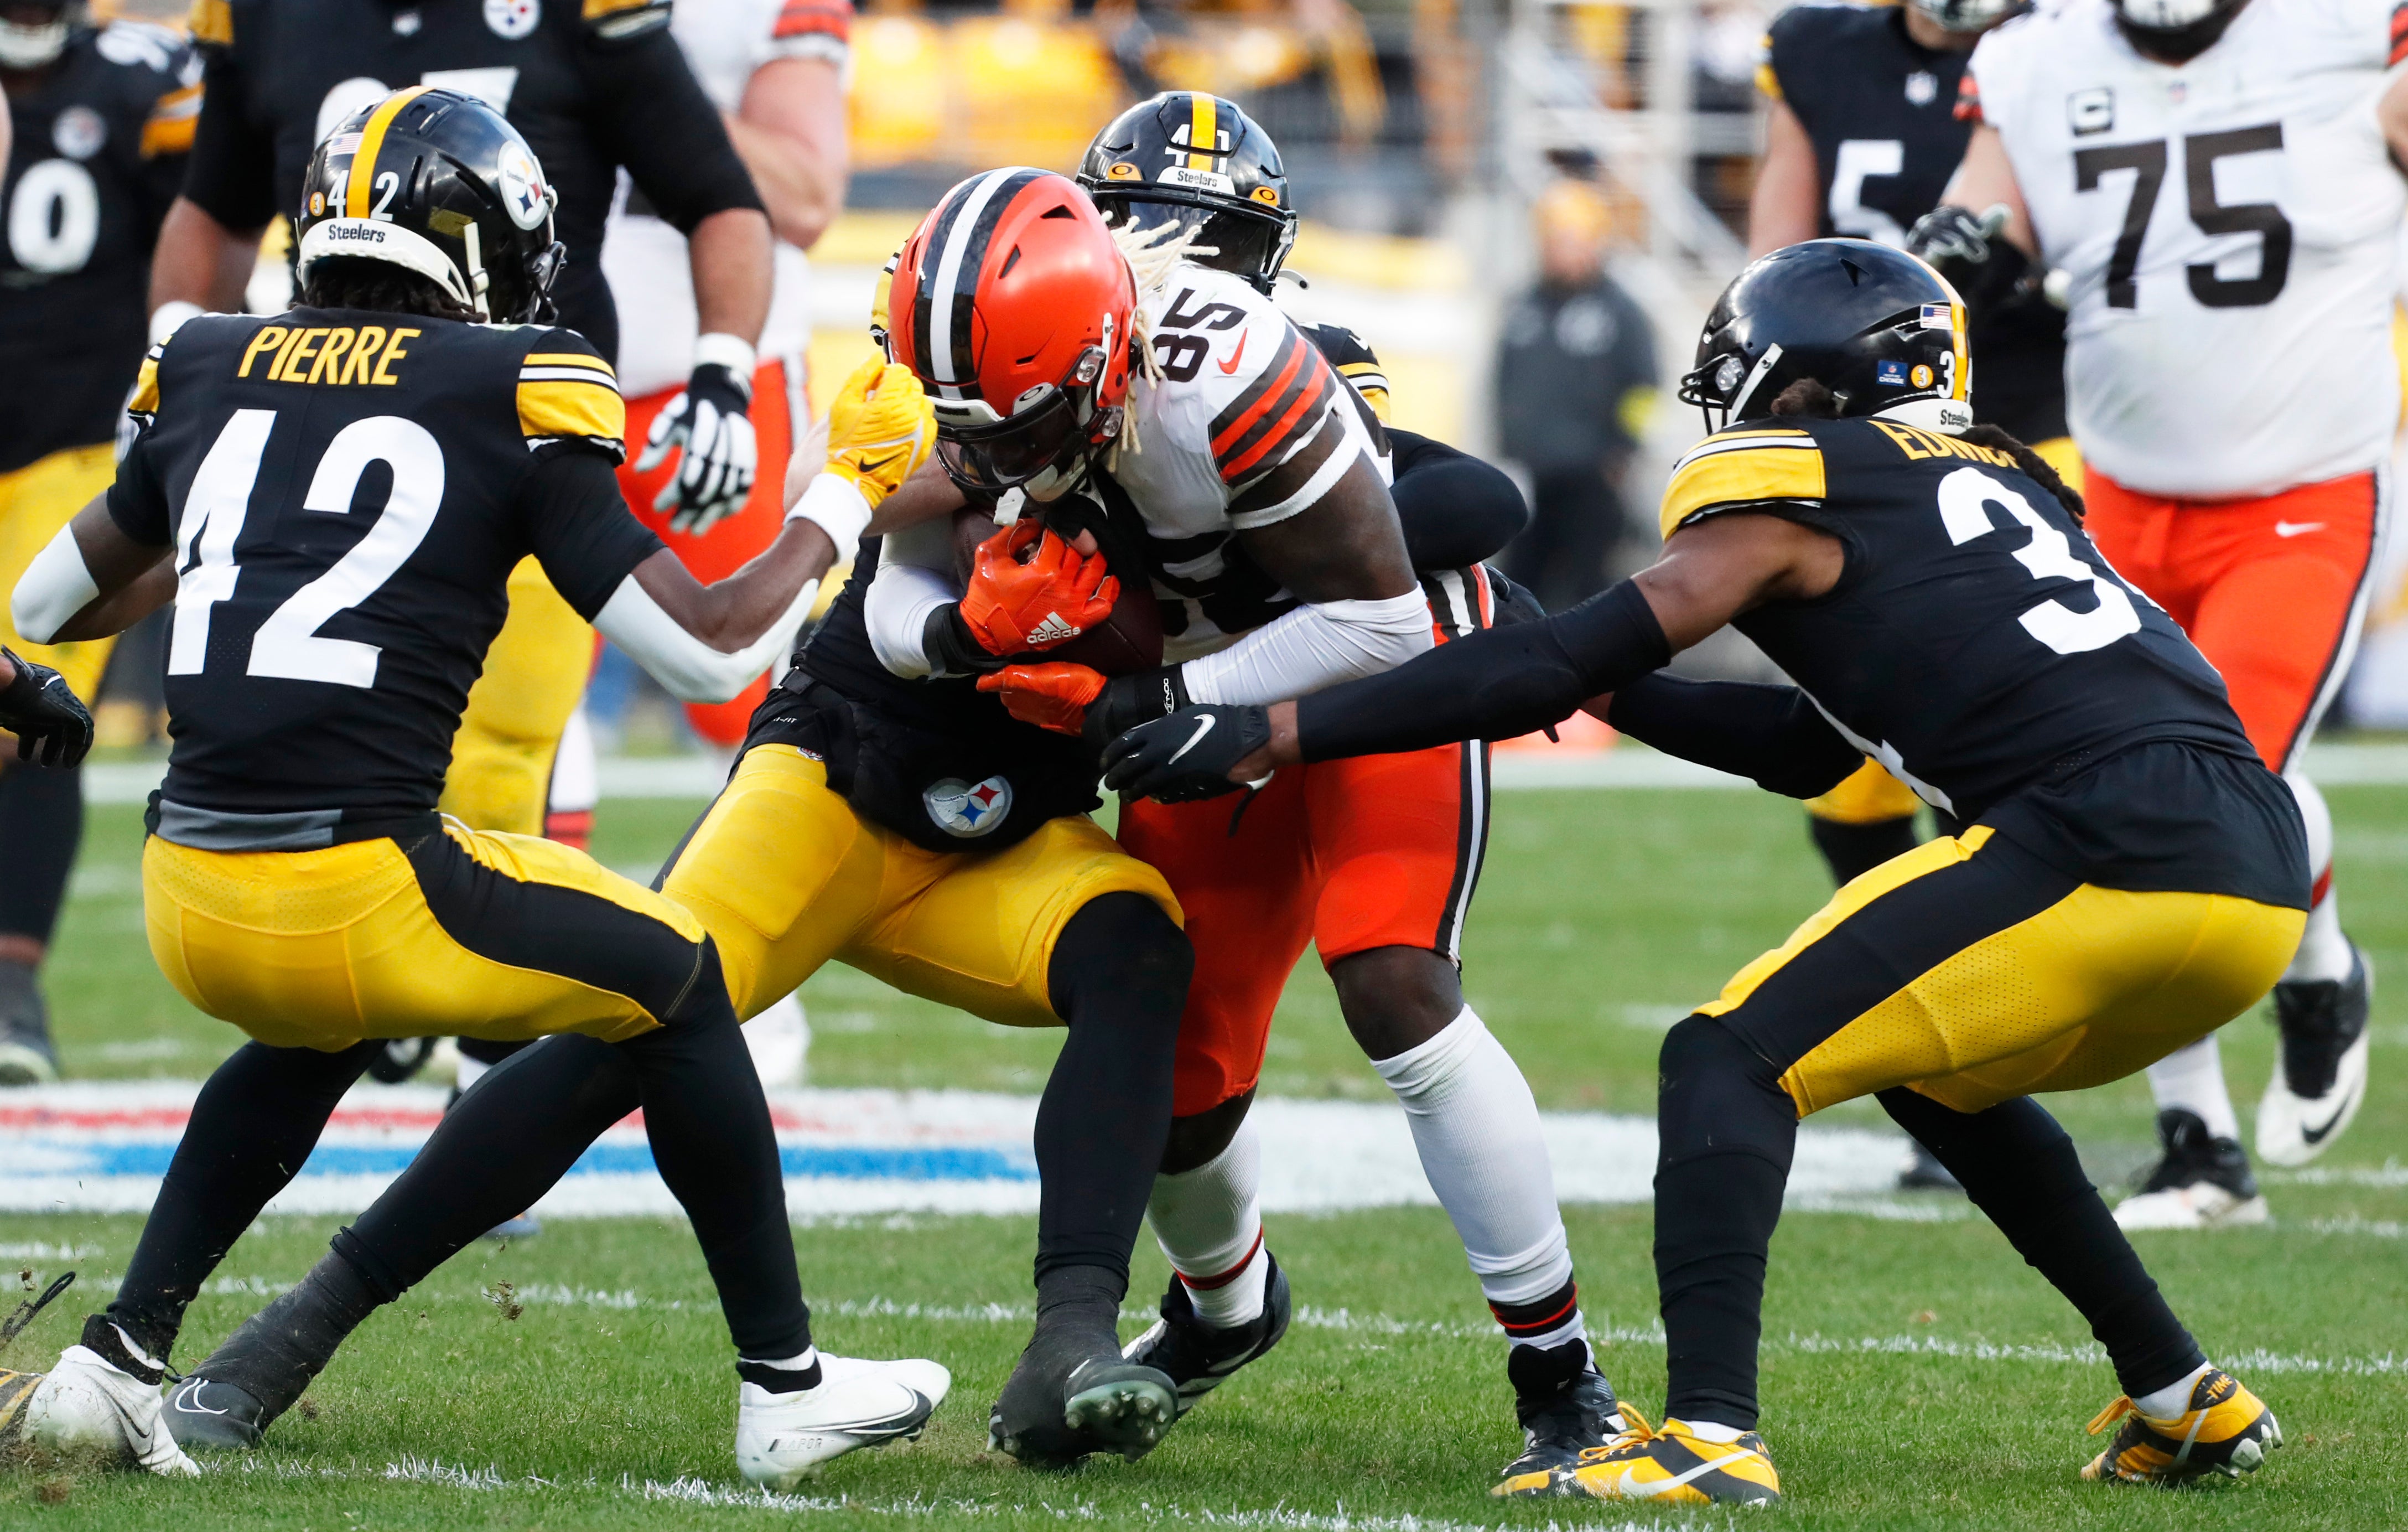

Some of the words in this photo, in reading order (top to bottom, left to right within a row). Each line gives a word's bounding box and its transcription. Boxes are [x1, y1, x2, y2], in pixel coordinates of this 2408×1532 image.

[327, 170, 399, 221] 42
[1177, 170, 1217, 187] Steelers
[329, 223, 386, 243] Steelers
[2072, 118, 2294, 311] 75
[238, 326, 421, 386] PIERRE
[1139, 287, 1248, 382] 85
[168, 408, 445, 689] 42
[1027, 627, 1081, 643] adidas
